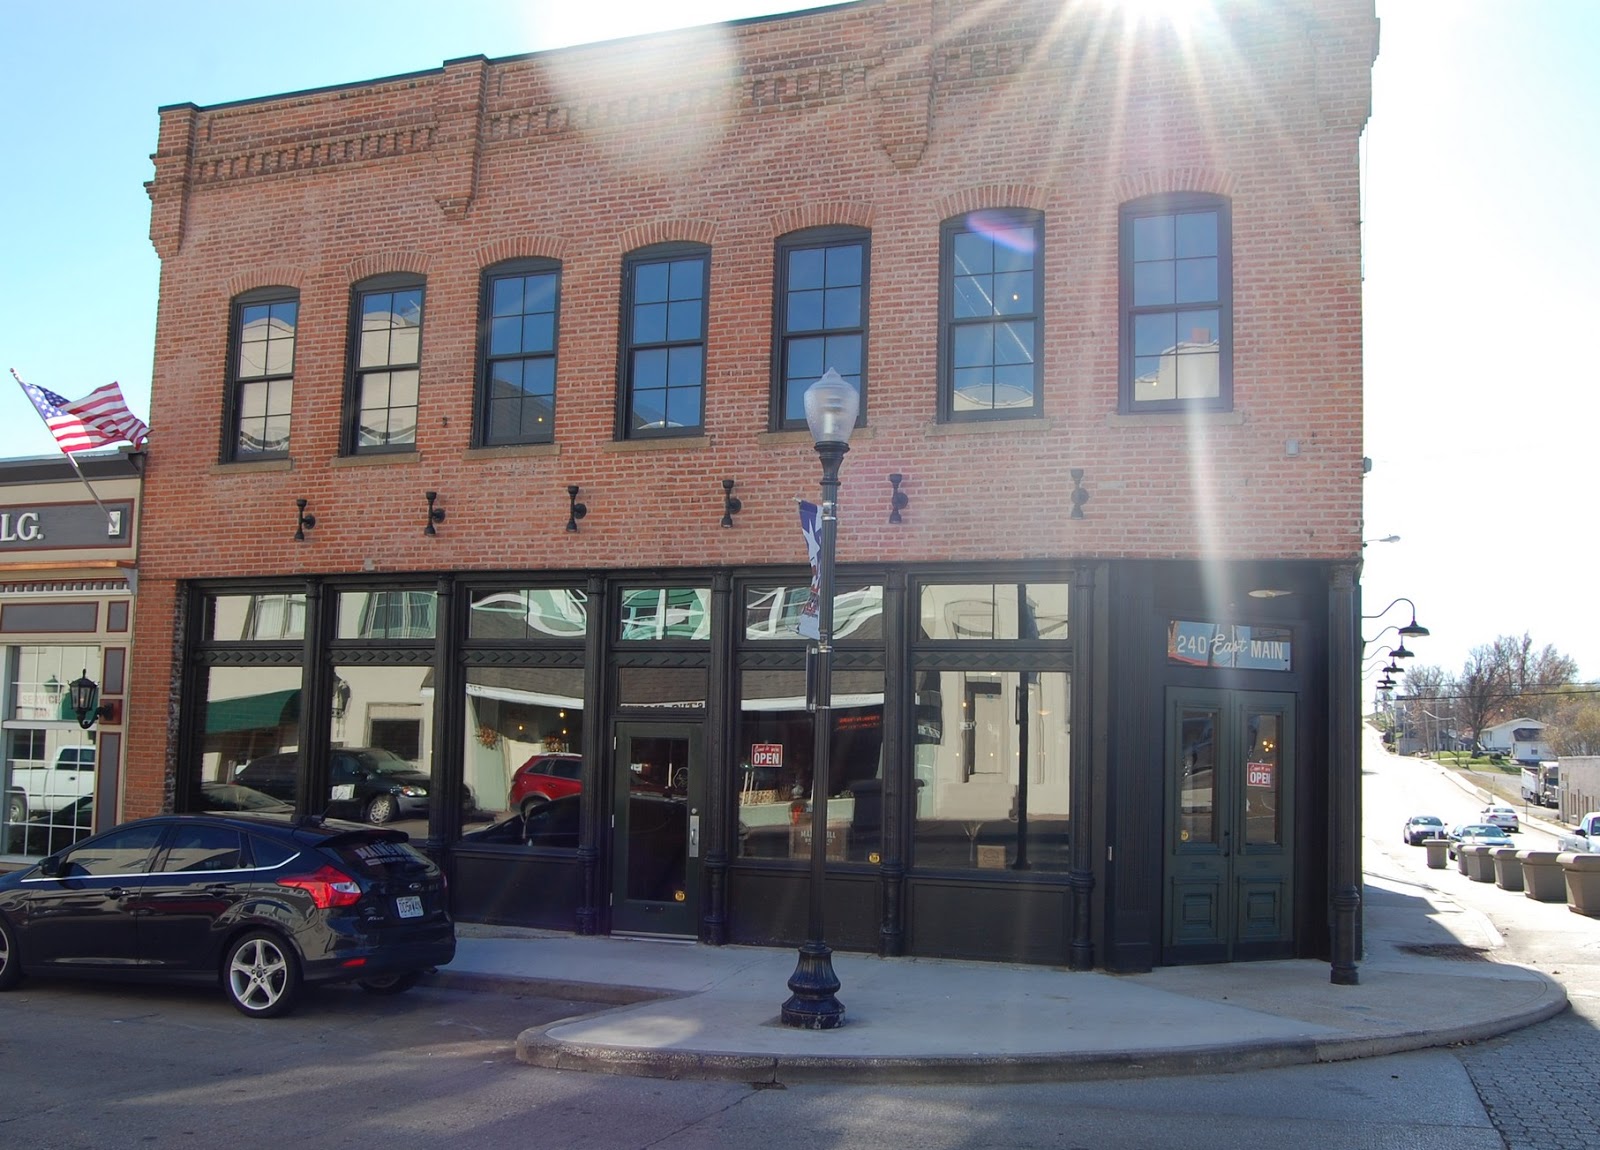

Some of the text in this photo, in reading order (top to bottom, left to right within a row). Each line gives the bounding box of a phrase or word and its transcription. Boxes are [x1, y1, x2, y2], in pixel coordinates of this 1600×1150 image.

[1177, 634, 1283, 659] 240 East MAIN
[754, 752, 780, 765] OPEN
[1250, 771, 1271, 784] OPEN
